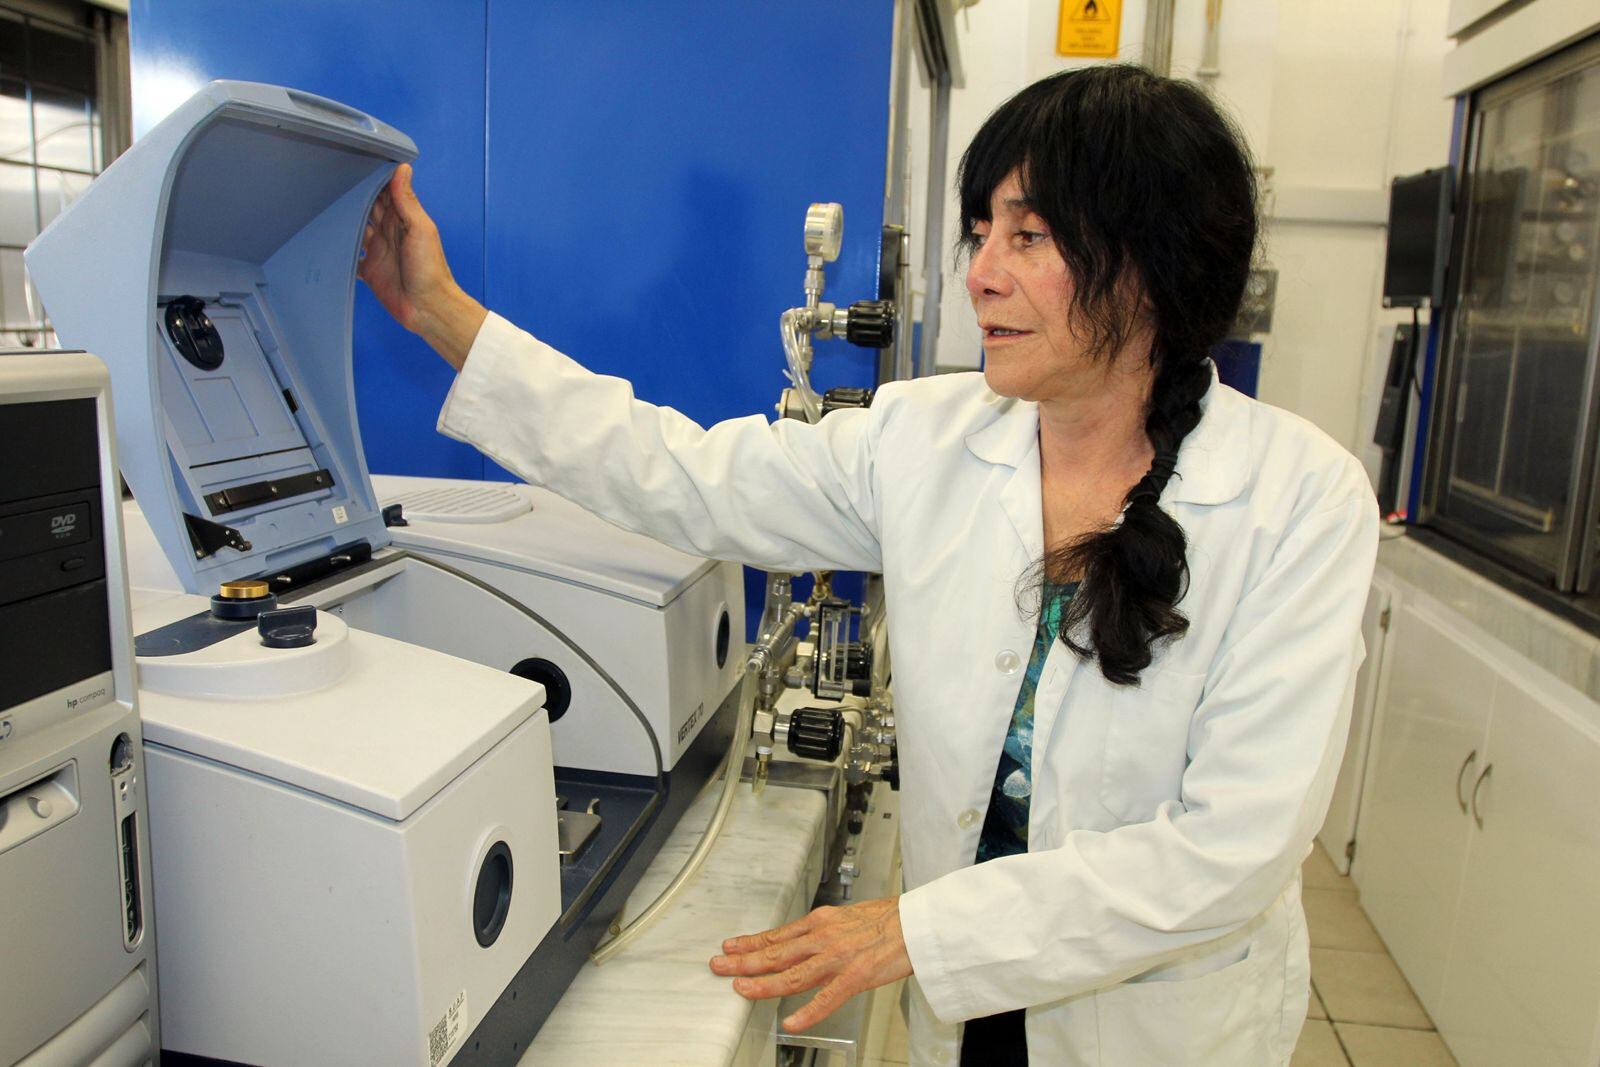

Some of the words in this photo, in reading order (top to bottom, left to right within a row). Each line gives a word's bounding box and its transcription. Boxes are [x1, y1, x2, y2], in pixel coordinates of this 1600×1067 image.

[51, 513, 76, 528] DVD
[67, 699, 78, 709] hp
[79, 688, 106, 704] compaq
[677, 710, 697, 744] VERTEX
